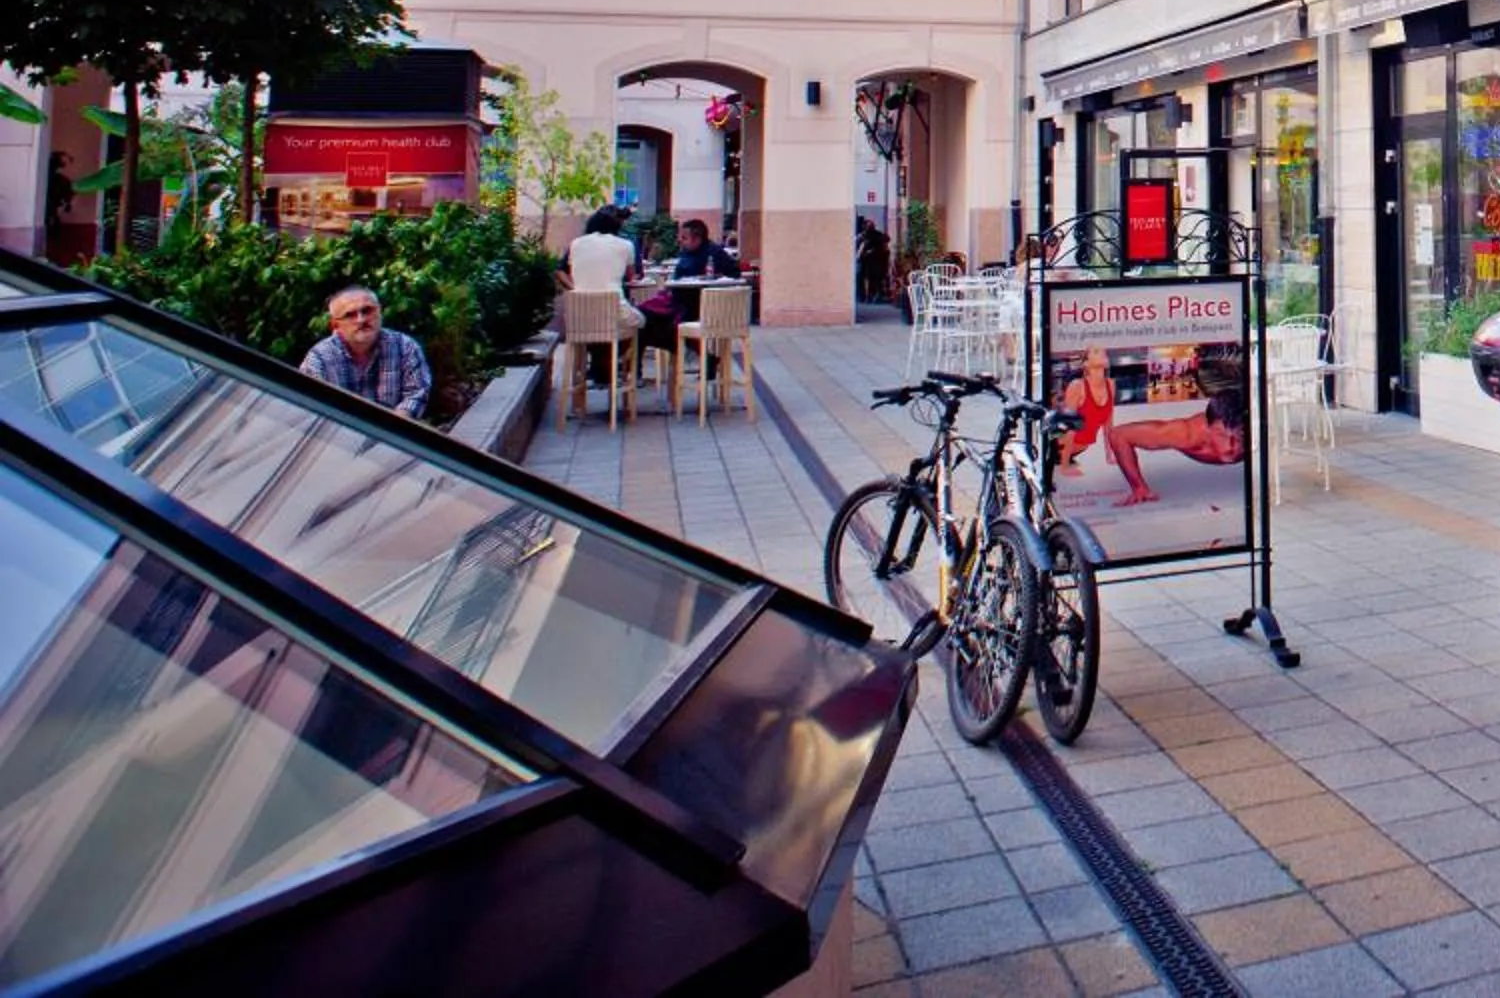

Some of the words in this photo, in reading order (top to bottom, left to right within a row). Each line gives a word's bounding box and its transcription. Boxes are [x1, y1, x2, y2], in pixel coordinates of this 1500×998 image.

[284, 135, 316, 148] Your
[319, 137, 379, 150] premium
[381, 136, 421, 148] health
[424, 135, 452, 148] club
[1056, 299, 1158, 325] Holmes
[1168, 295, 1232, 320] Place
